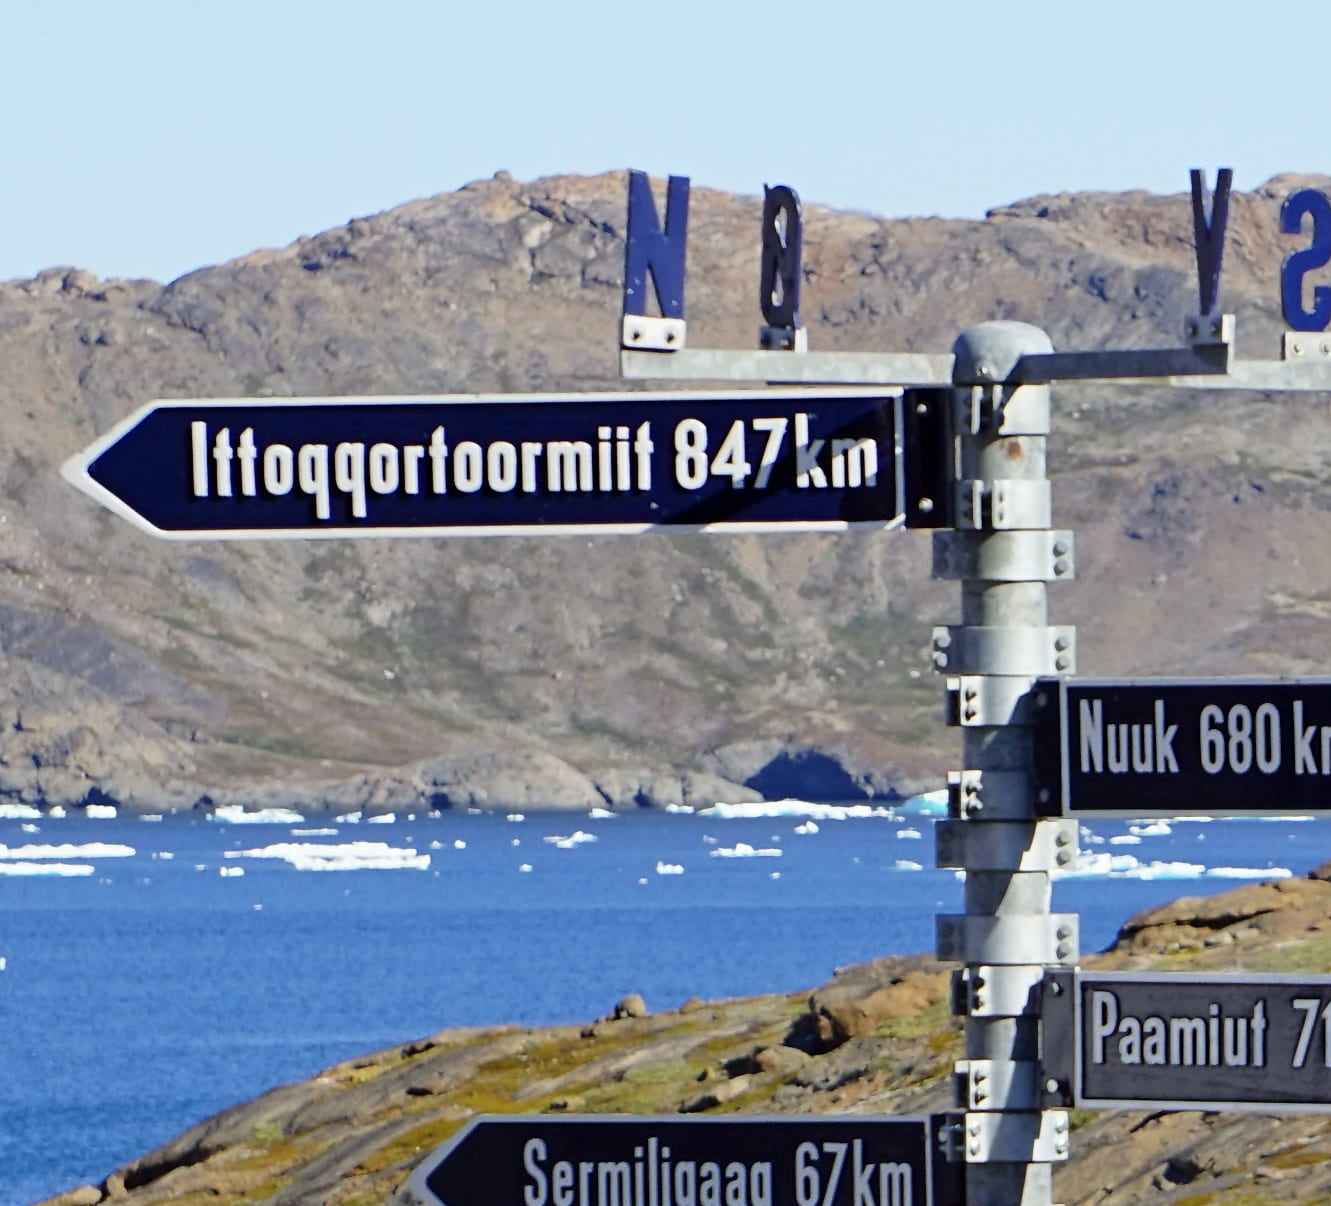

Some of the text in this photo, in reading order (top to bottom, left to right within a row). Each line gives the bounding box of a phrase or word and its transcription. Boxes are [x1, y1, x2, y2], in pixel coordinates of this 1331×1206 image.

[623, 169, 690, 318] N
[190, 420, 655, 519] Ittoqqortoormiit
[1079, 699, 1179, 774] Nuuk
[1199, 702, 1281, 775] 680
[1092, 991, 1266, 1067] Paamiut
